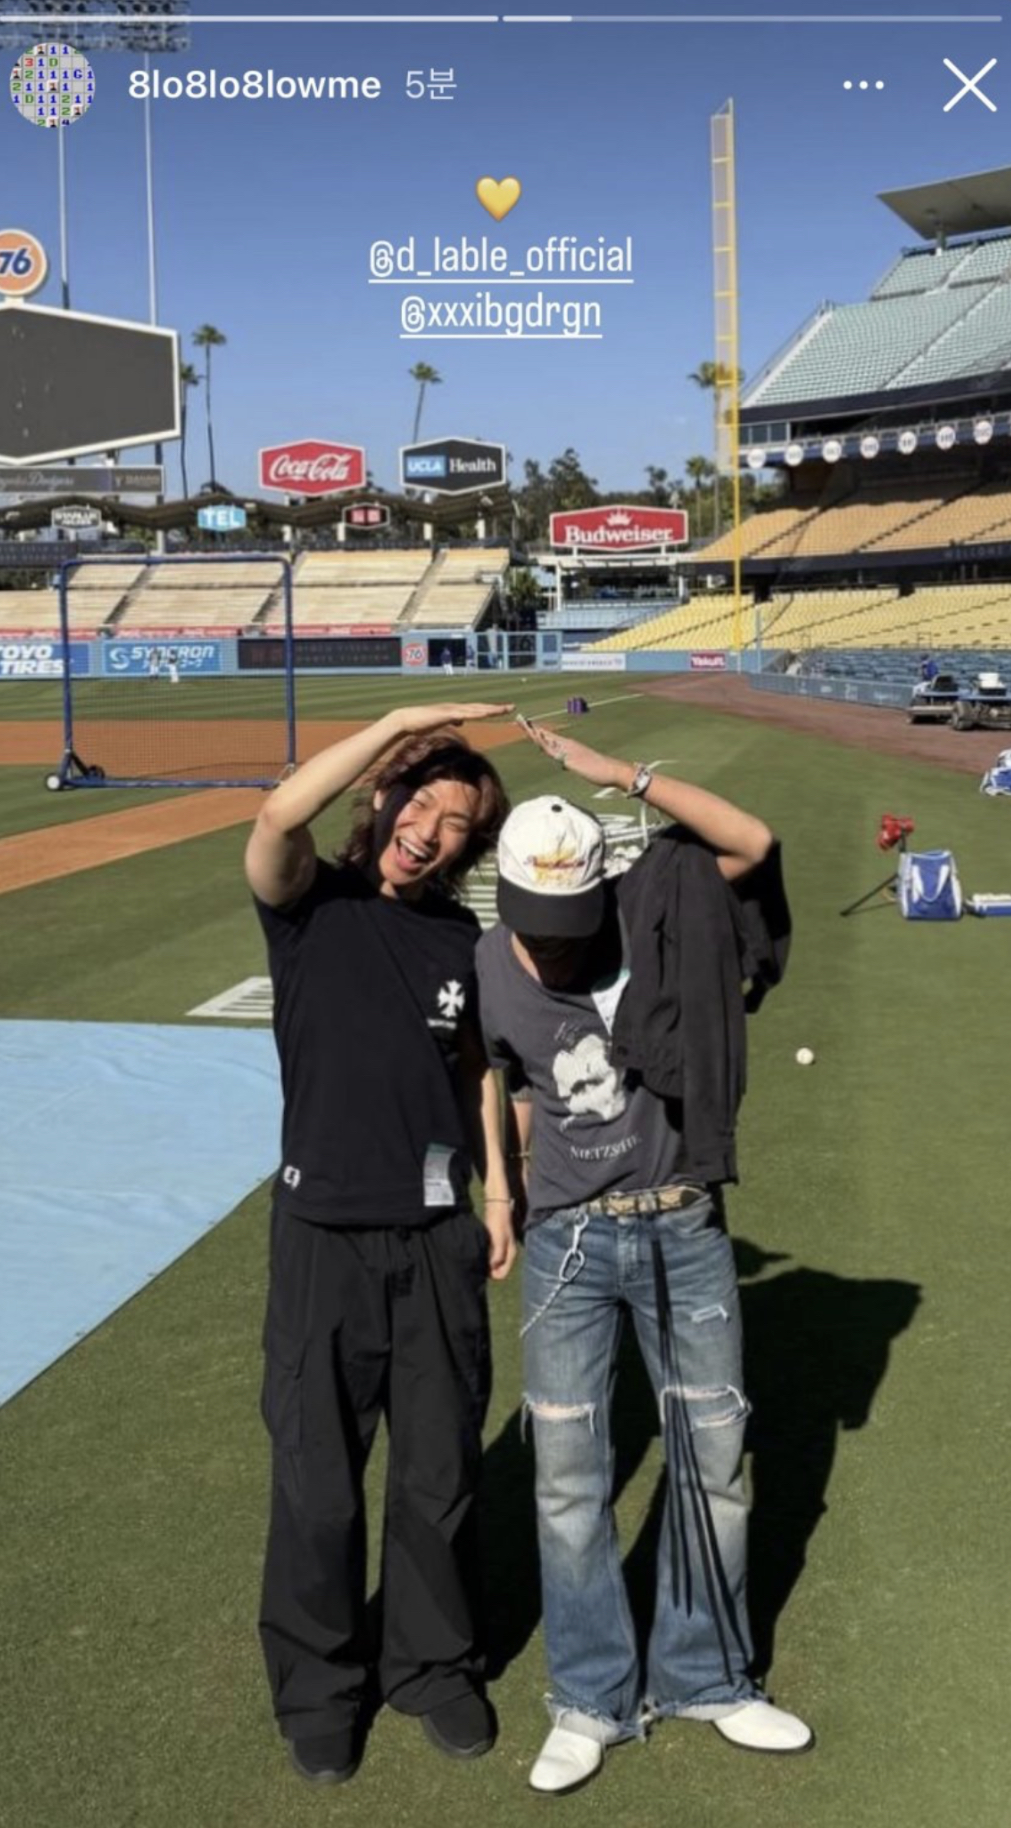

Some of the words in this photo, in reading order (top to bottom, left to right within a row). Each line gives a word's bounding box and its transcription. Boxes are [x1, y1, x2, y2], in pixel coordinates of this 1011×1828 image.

[0, 247, 32, 275] 76
[407, 458, 444, 473] UCLA
[449, 457, 497, 474] Health
[204, 509, 240, 526] TEL
[564, 524, 674, 544] Budweiser
